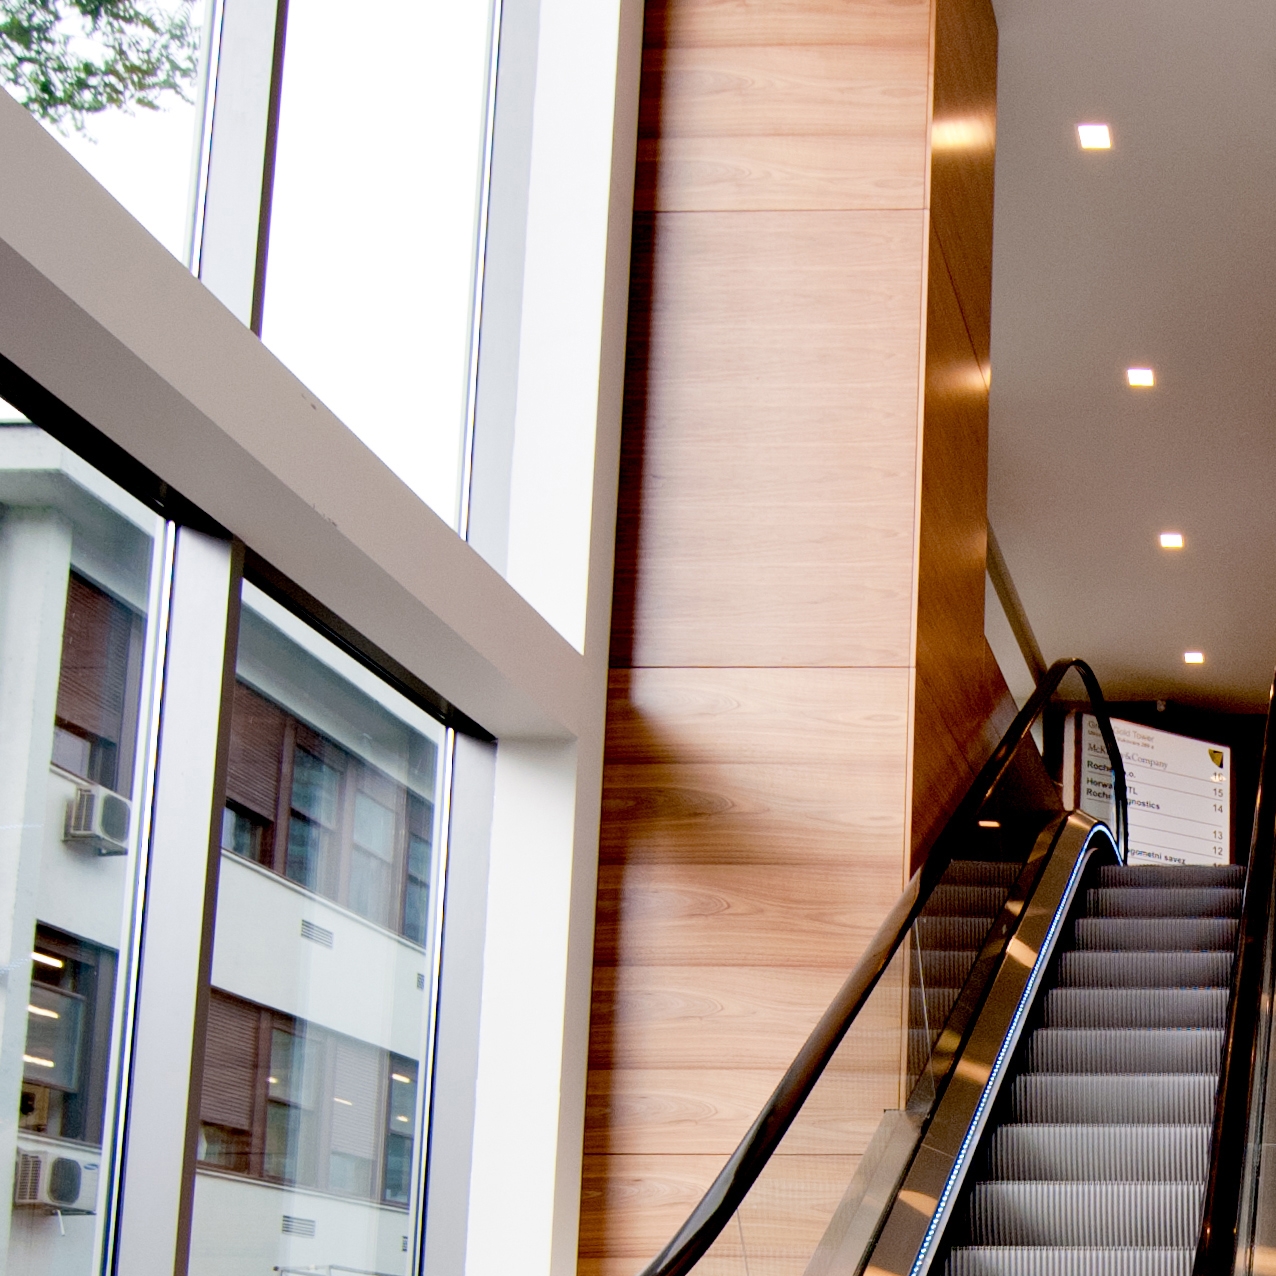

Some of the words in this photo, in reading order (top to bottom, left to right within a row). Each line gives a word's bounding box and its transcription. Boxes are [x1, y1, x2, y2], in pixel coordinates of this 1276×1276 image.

[1132, 730, 1154, 742] Tower
[1086, 777, 1113, 789] Horwa
[1213, 788, 1223, 797] 15
[1213, 804, 1223, 813] 14
[1213, 830, 1223, 840] 13
[1128, 848, 1162, 860] gometni
[1212, 846, 1223, 856] 12
